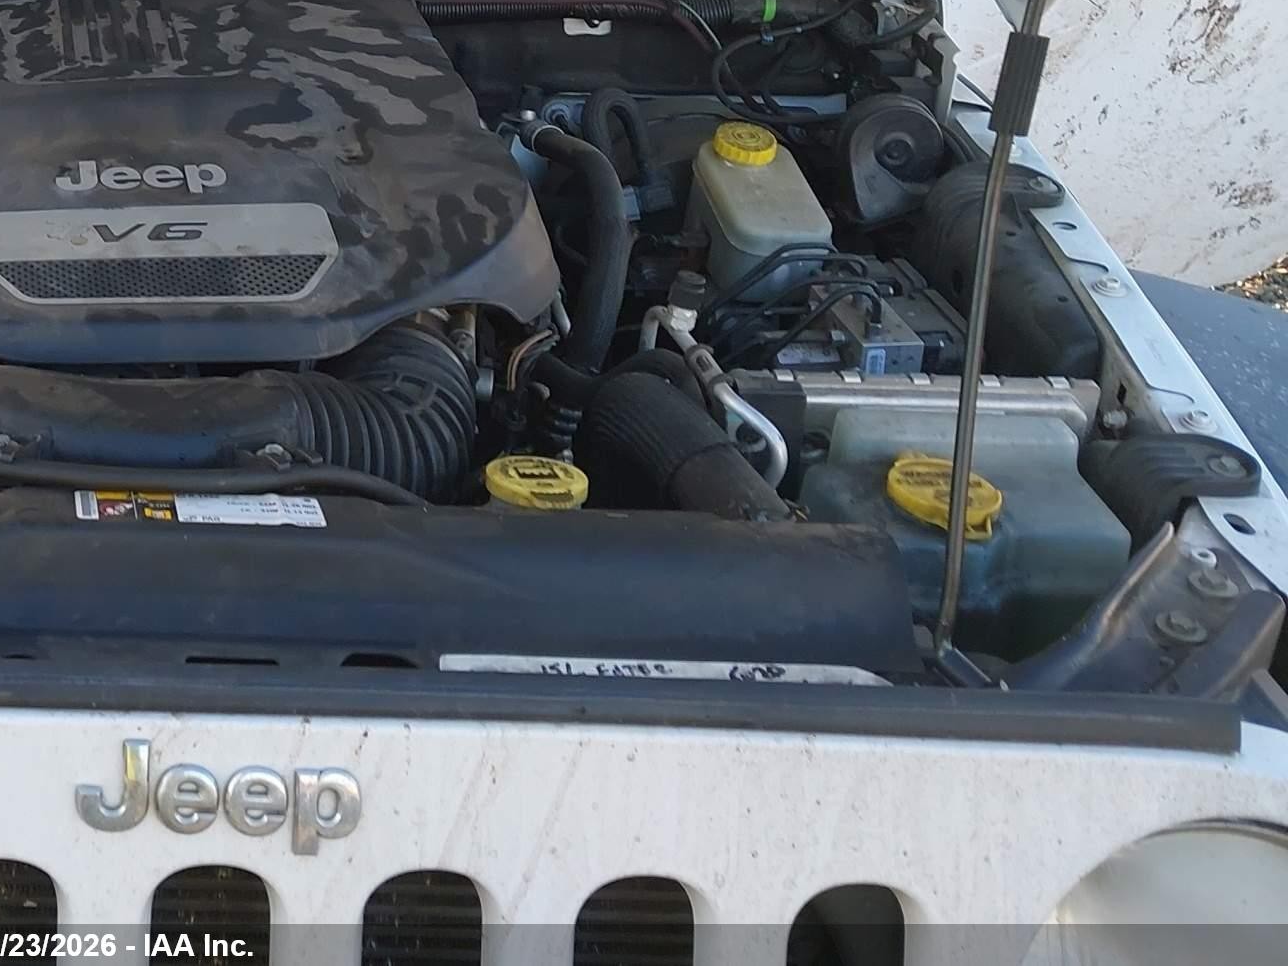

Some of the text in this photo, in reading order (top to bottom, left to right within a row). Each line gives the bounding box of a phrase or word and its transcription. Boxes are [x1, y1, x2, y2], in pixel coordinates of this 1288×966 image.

[55, 160, 227, 194] Jeep
[93, 222, 209, 243] V6
[75, 739, 362, 856] Jeep
